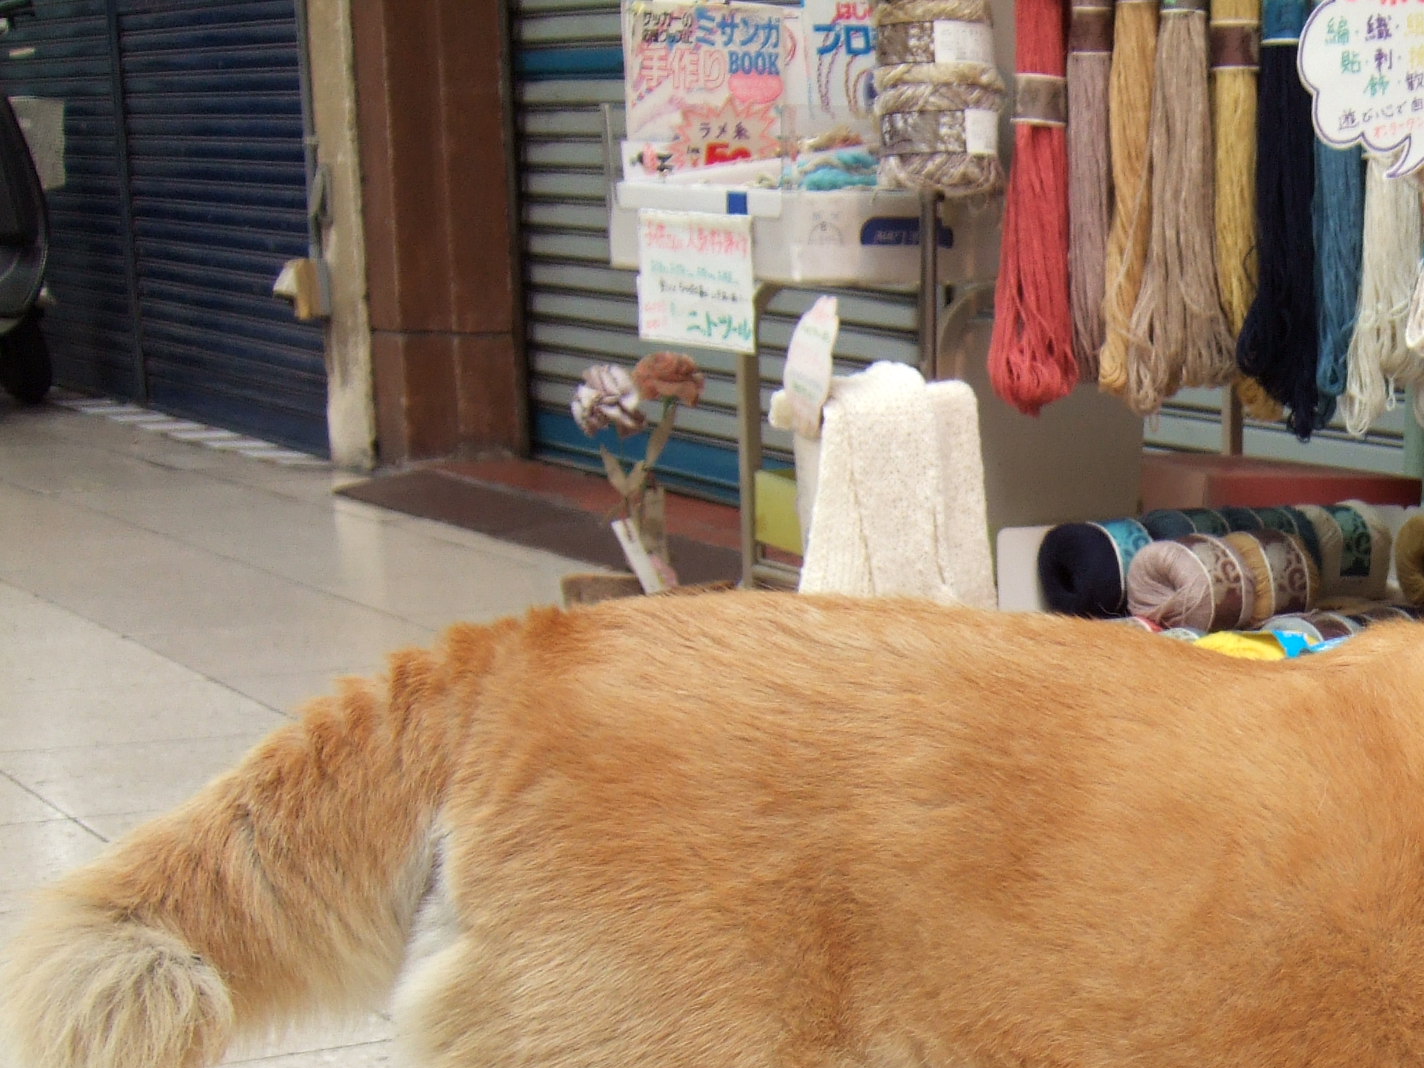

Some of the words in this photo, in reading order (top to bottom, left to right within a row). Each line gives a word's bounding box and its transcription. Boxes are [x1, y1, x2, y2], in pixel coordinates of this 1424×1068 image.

[695, 9, 781, 49] ミサンガ
[813, 24, 877, 55] プロ
[638, 45, 727, 91] 手作り
[728, 51, 780, 75] BOOK
